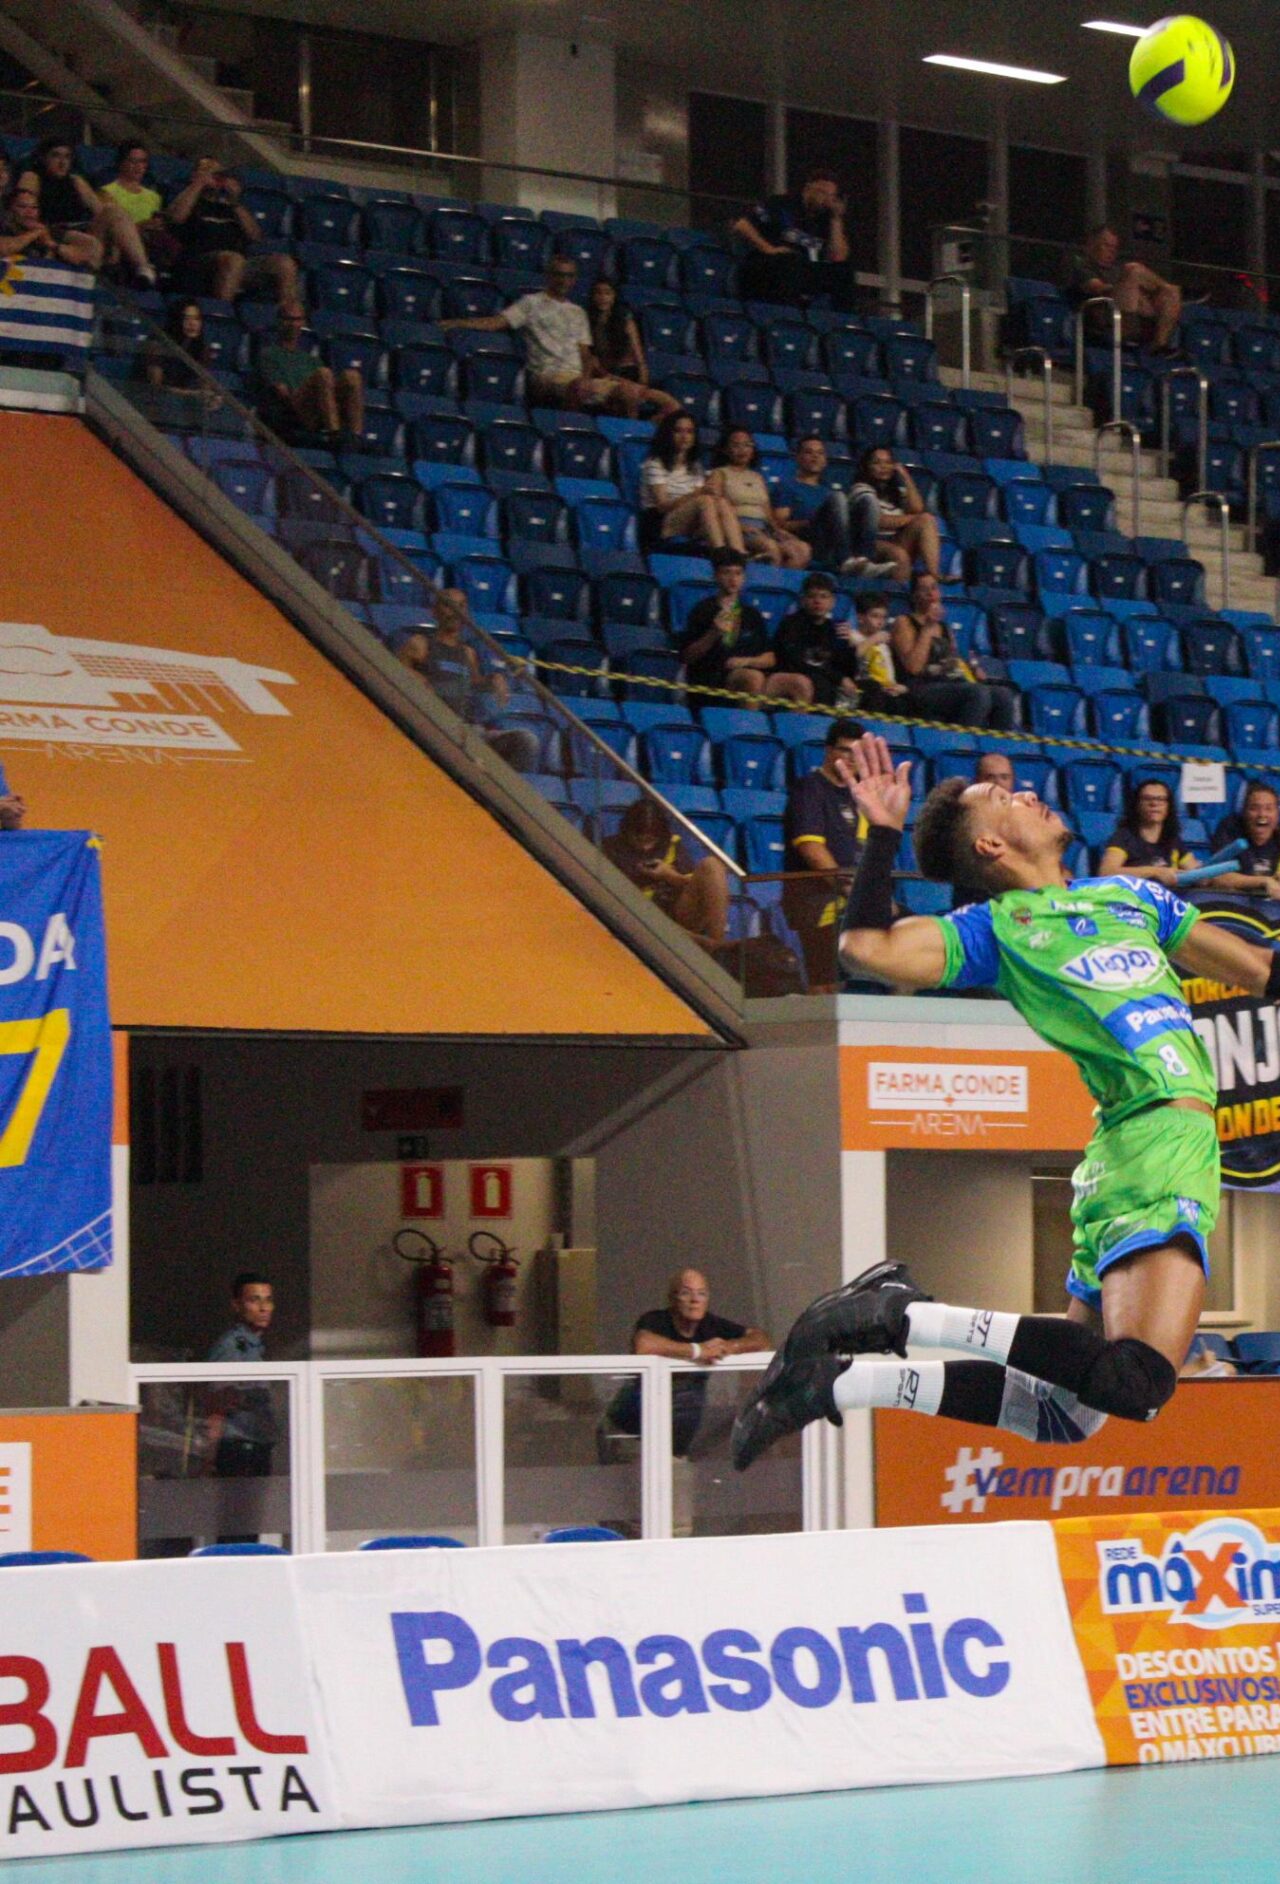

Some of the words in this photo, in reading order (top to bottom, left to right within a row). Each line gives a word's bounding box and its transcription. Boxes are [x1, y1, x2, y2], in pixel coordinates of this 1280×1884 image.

[83, 715, 216, 738] CONDE
[46, 742, 184, 766] ARENA
[1158, 1043, 1190, 1077] 8
[876, 1072, 945, 1094] FARMA
[953, 1074, 1021, 1095] CONDE
[911, 1113, 987, 1136] ARENA
[1105, 1547, 1137, 1560] REDE
[390, 1592, 1012, 1727] Panasonic
[1116, 1646, 1277, 1681] DESCONTOS
[1129, 1707, 1217, 1739] ENTRE
[7, 1765, 320, 1834] AULISTA
